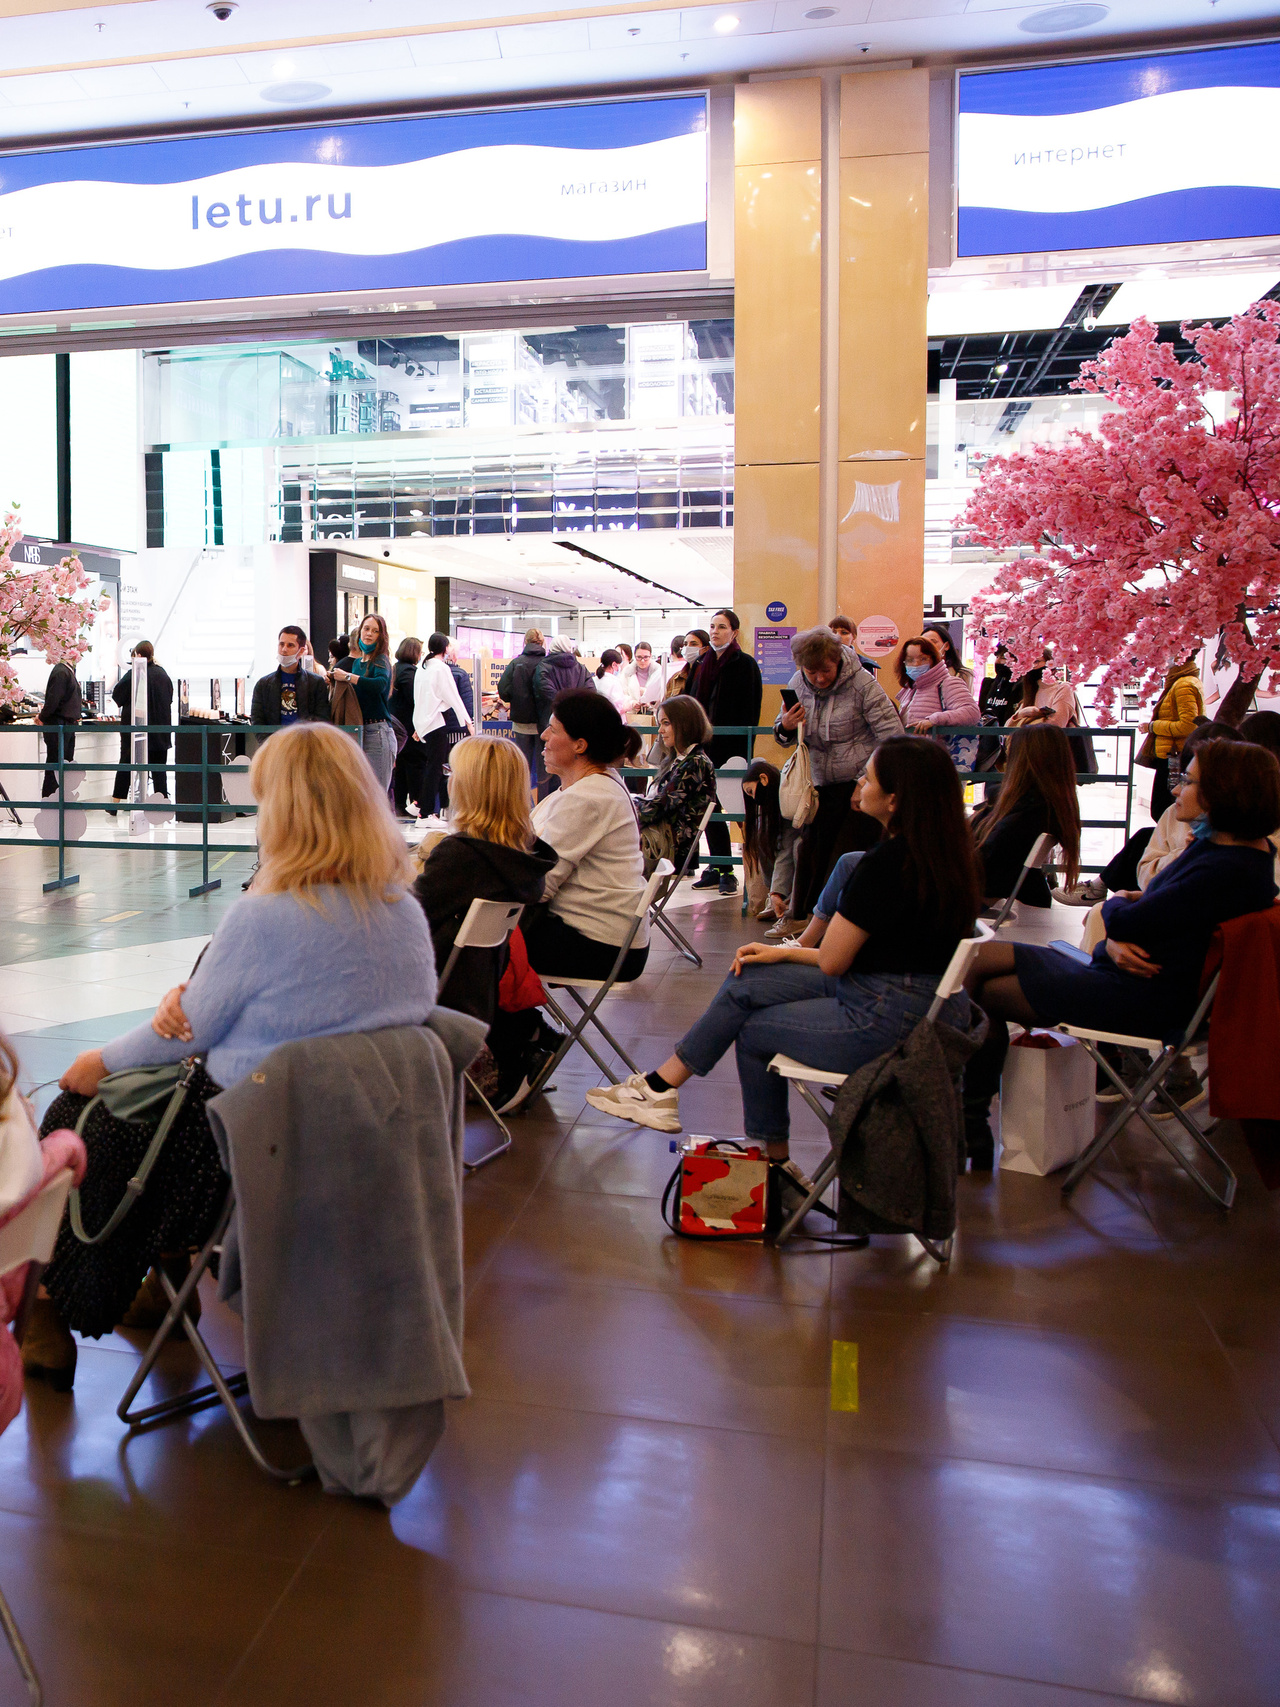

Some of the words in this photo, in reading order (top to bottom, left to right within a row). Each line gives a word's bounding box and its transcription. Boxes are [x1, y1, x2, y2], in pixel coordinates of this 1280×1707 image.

[1014, 143, 1127, 166] интернет
[191, 191, 352, 230] letu.ru
[560, 178, 647, 196] магазин
